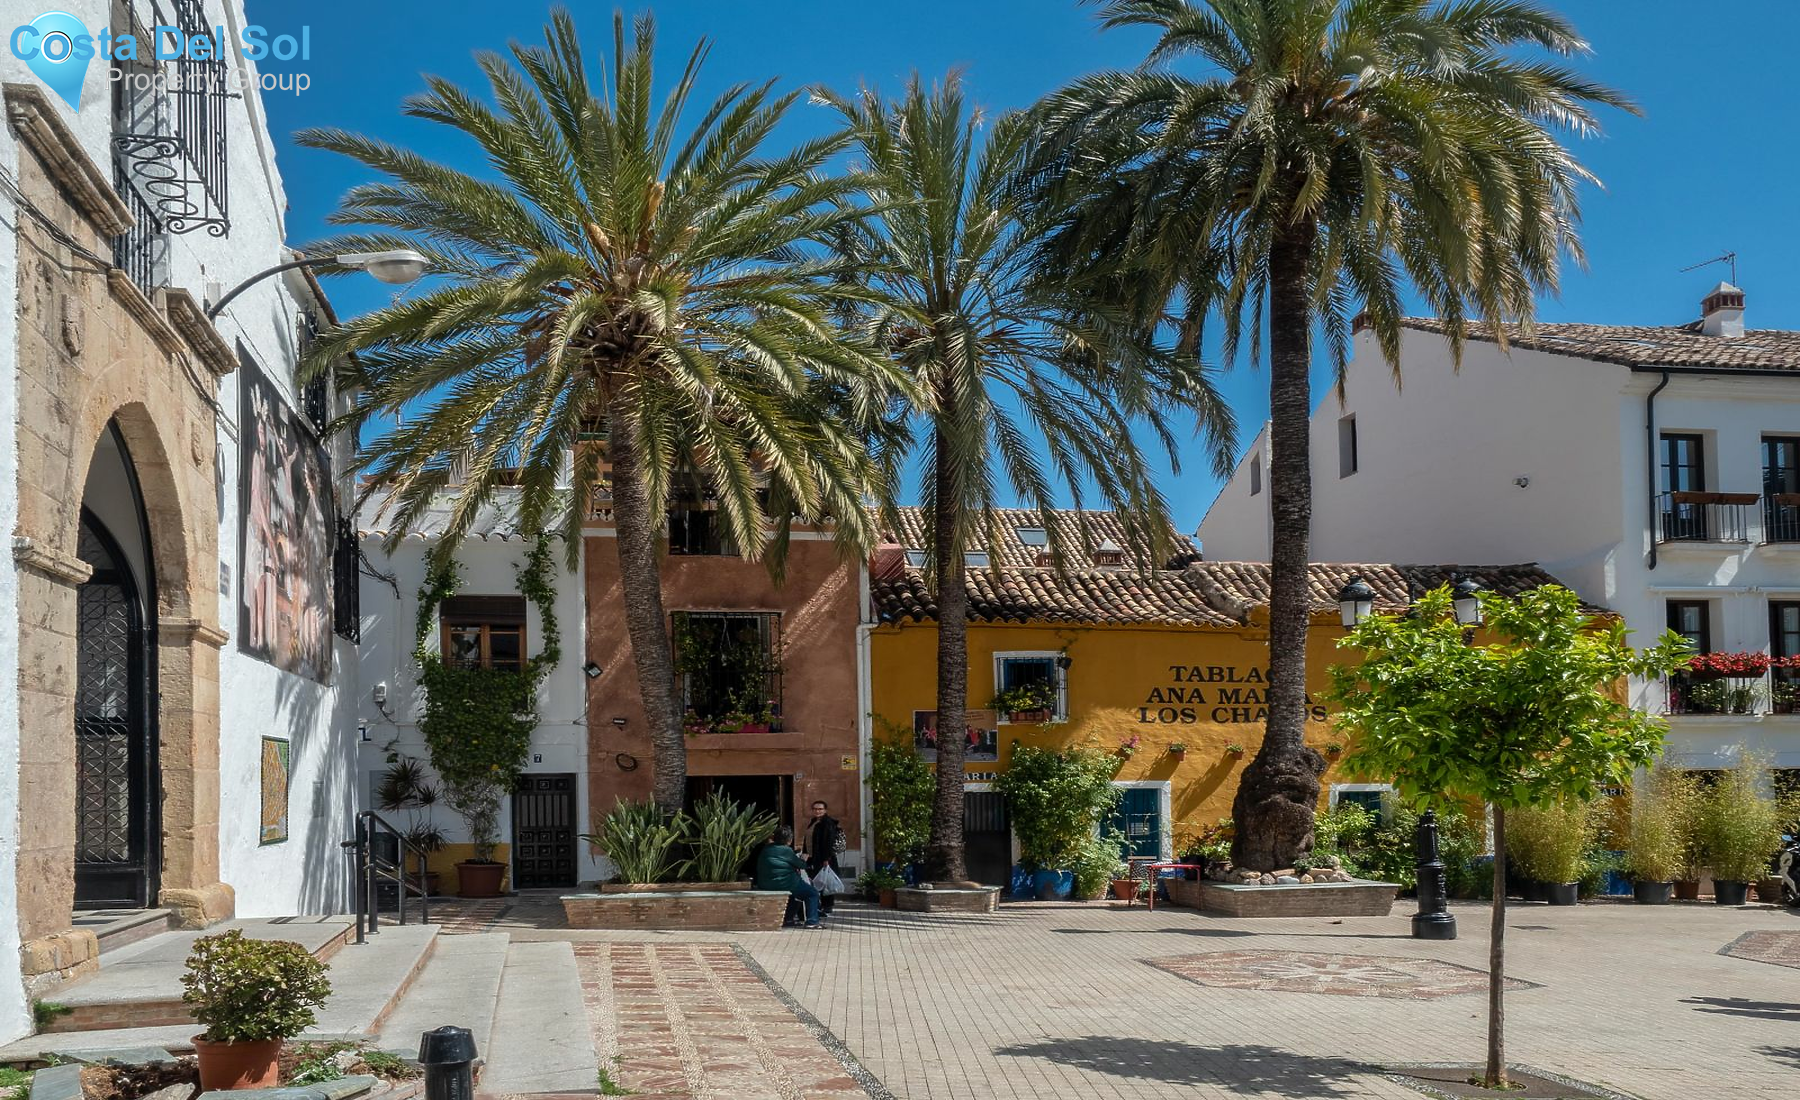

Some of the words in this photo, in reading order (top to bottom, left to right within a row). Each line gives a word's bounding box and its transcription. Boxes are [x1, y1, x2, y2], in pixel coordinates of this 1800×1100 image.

[1146, 687, 1206, 704] ANA
[1139, 707, 1197, 724] LOS
[1211, 706, 1327, 724] CHAS
[963, 772, 998, 781] ARIA
